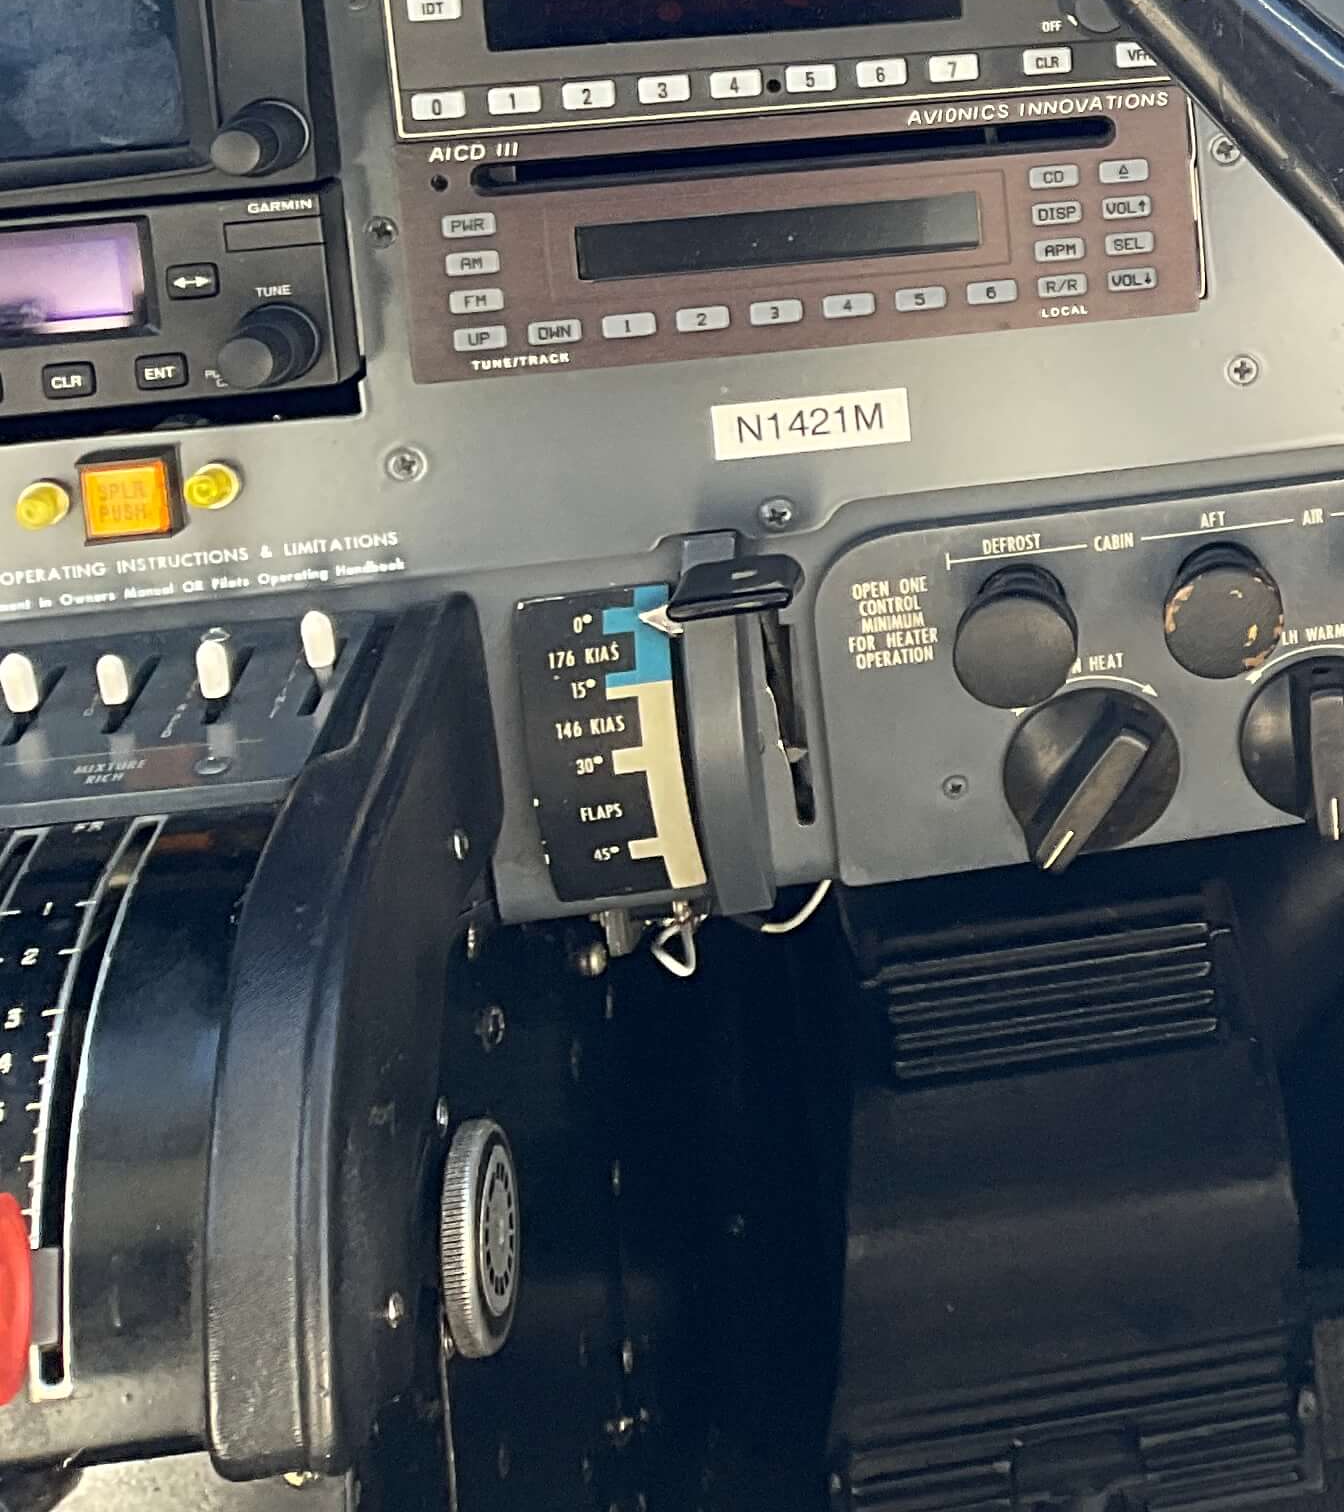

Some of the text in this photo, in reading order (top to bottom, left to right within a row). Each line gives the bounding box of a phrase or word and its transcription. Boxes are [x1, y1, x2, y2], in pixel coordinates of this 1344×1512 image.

[421, 2, 443, 15] IDT
[1042, 20, 1061, 33] OFF
[1035, 56, 1059, 69] CLR
[907, 92, 1168, 126] AVIONICS INNOVATIONS
[429, 144, 485, 162] AICD
[1043, 170, 1064, 184] CD
[248, 199, 312, 214] GARMIN
[1038, 205, 1076, 221] DISP
[451, 217, 485, 232] PWR
[1045, 243, 1076, 257] APM
[1114, 238, 1144, 251] SEL
[460, 256, 483, 270] AM
[256, 285, 292, 296] TUNE
[1046, 278, 1078, 293] R/R
[464, 295, 487, 308] FM
[1041, 305, 1088, 318] LOCAL
[468, 332, 489, 346] UP
[537, 325, 571, 340] DWN
[472, 352, 570, 372] TUNE/TRACK
[144, 367, 174, 380] ENT
[51, 376, 82, 389] CLR
[737, 403, 884, 443] N1421M
[99, 504, 148, 523] PUSH
[1200, 511, 1226, 529] AFT
[1303, 509, 1324, 525] AIR
[982, 534, 1041, 555] DEFROST
[1094, 533, 1134, 552] CABIN
[1, 531, 399, 587] OPERATING INSTRUCTIONS & LIMITATIONS
[258, 558, 405, 588] Operating Handbook
[852, 576, 928, 601] OPEN ONE
[859, 595, 921, 616] CONTROL
[862, 613, 924, 633] MINIMUM
[849, 627, 938, 652] FOR HEATER
[1282, 629, 1298, 645] LH
[549, 642, 620, 669] 176 KIAS
[856, 647, 934, 670] OPERATION
[1089, 652, 1124, 671] HEAT
[556, 716, 625, 741] 146 KIAS
[73, 759, 147, 774] MIXTURE
[84, 772, 125, 785] RICH
[580, 802, 623, 823] FLAPS
